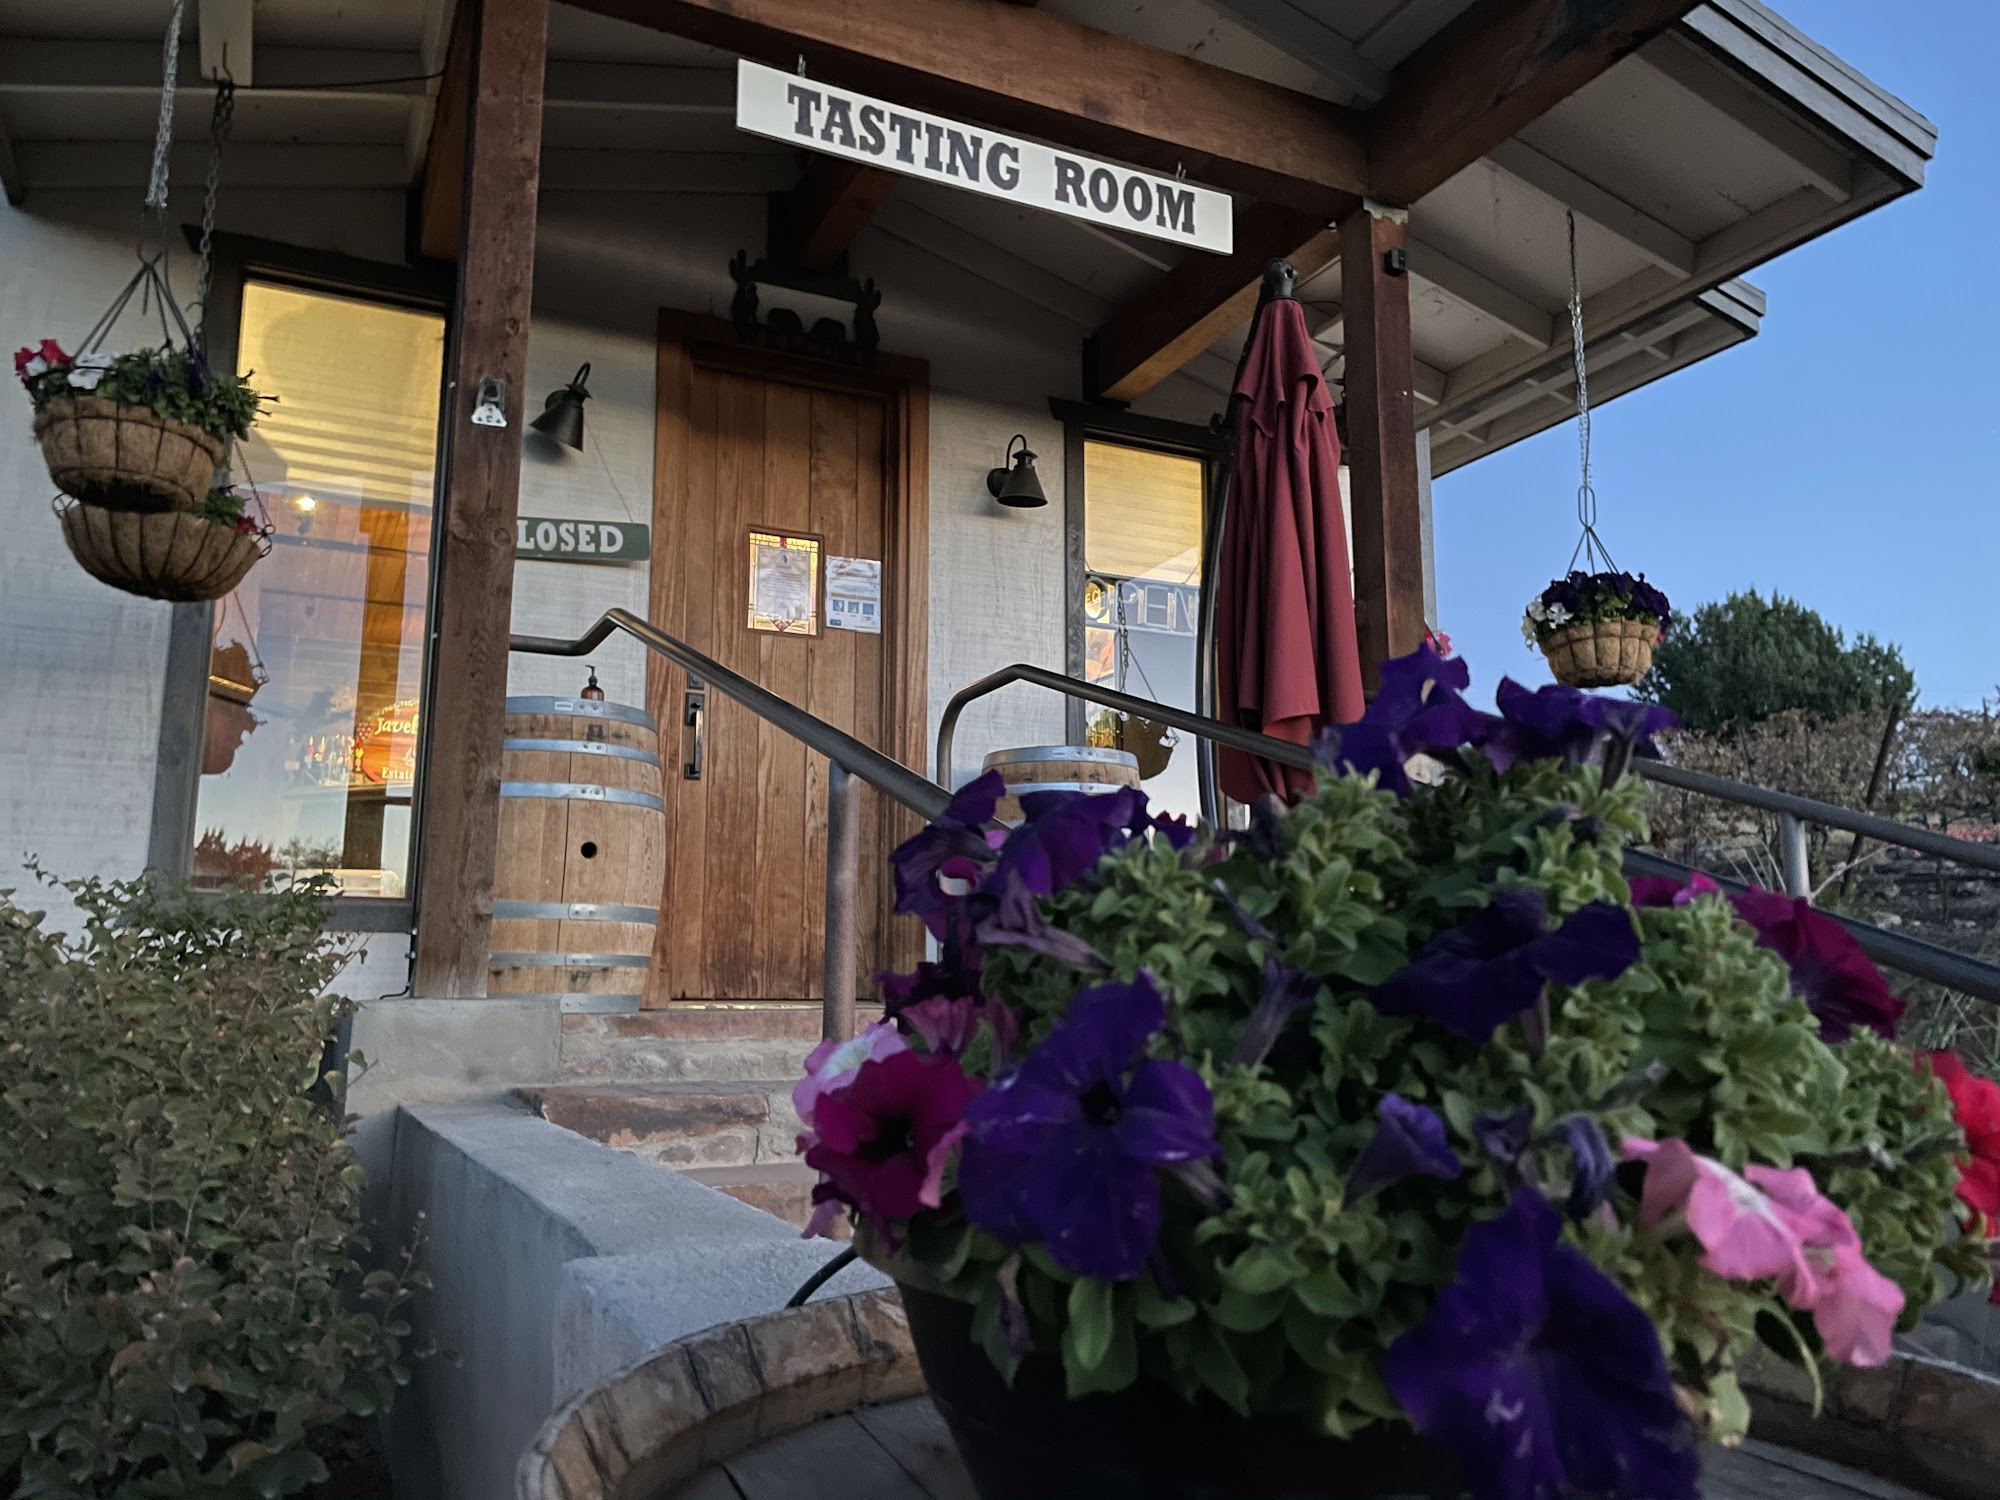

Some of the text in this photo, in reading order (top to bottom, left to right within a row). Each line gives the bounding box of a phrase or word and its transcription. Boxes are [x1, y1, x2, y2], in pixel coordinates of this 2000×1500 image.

[788, 83, 1196, 235] TASTING ROOM
[1085, 577, 1199, 633] OPEN
